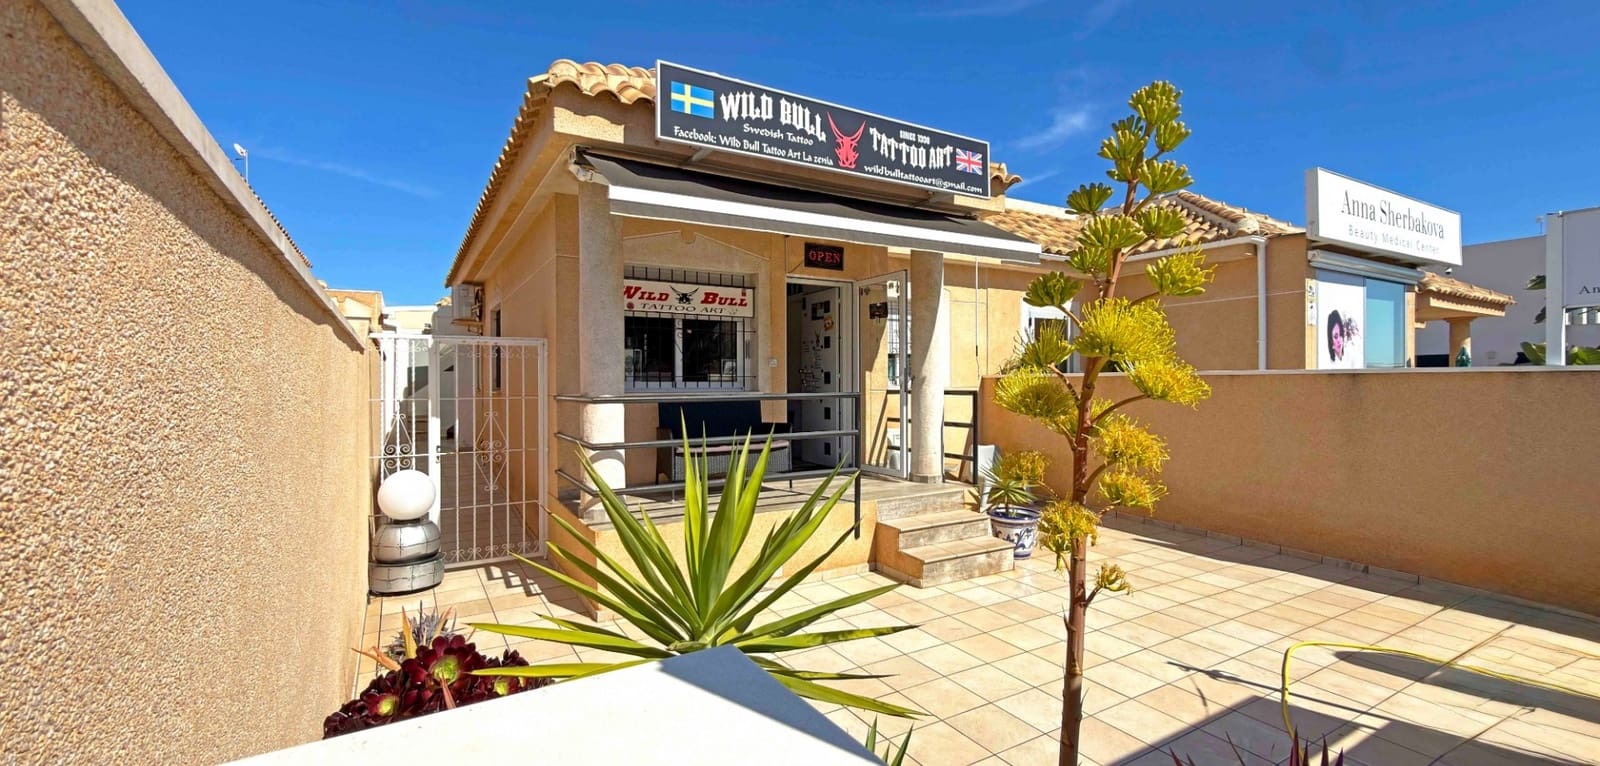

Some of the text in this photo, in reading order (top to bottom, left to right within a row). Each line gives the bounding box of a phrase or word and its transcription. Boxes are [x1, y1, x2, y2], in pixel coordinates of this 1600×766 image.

[719, 91, 827, 143] WILD BULL
[673, 126, 717, 144] Facebook:
[719, 134, 742, 148] Wild
[743, 139, 760, 152] Bull
[762, 143, 786, 157] Tattoo
[788, 147, 801, 160] Art
[743, 123, 814, 146] Swedish Tattoo
[869, 127, 953, 170] TATTOO ART
[1341, 189, 1445, 240] Anna Sherbakova
[1348, 224, 1440, 254] Beauty Medical Center
[808, 250, 841, 264] OPEN
[640, 302, 725, 314] TATTOO ART
